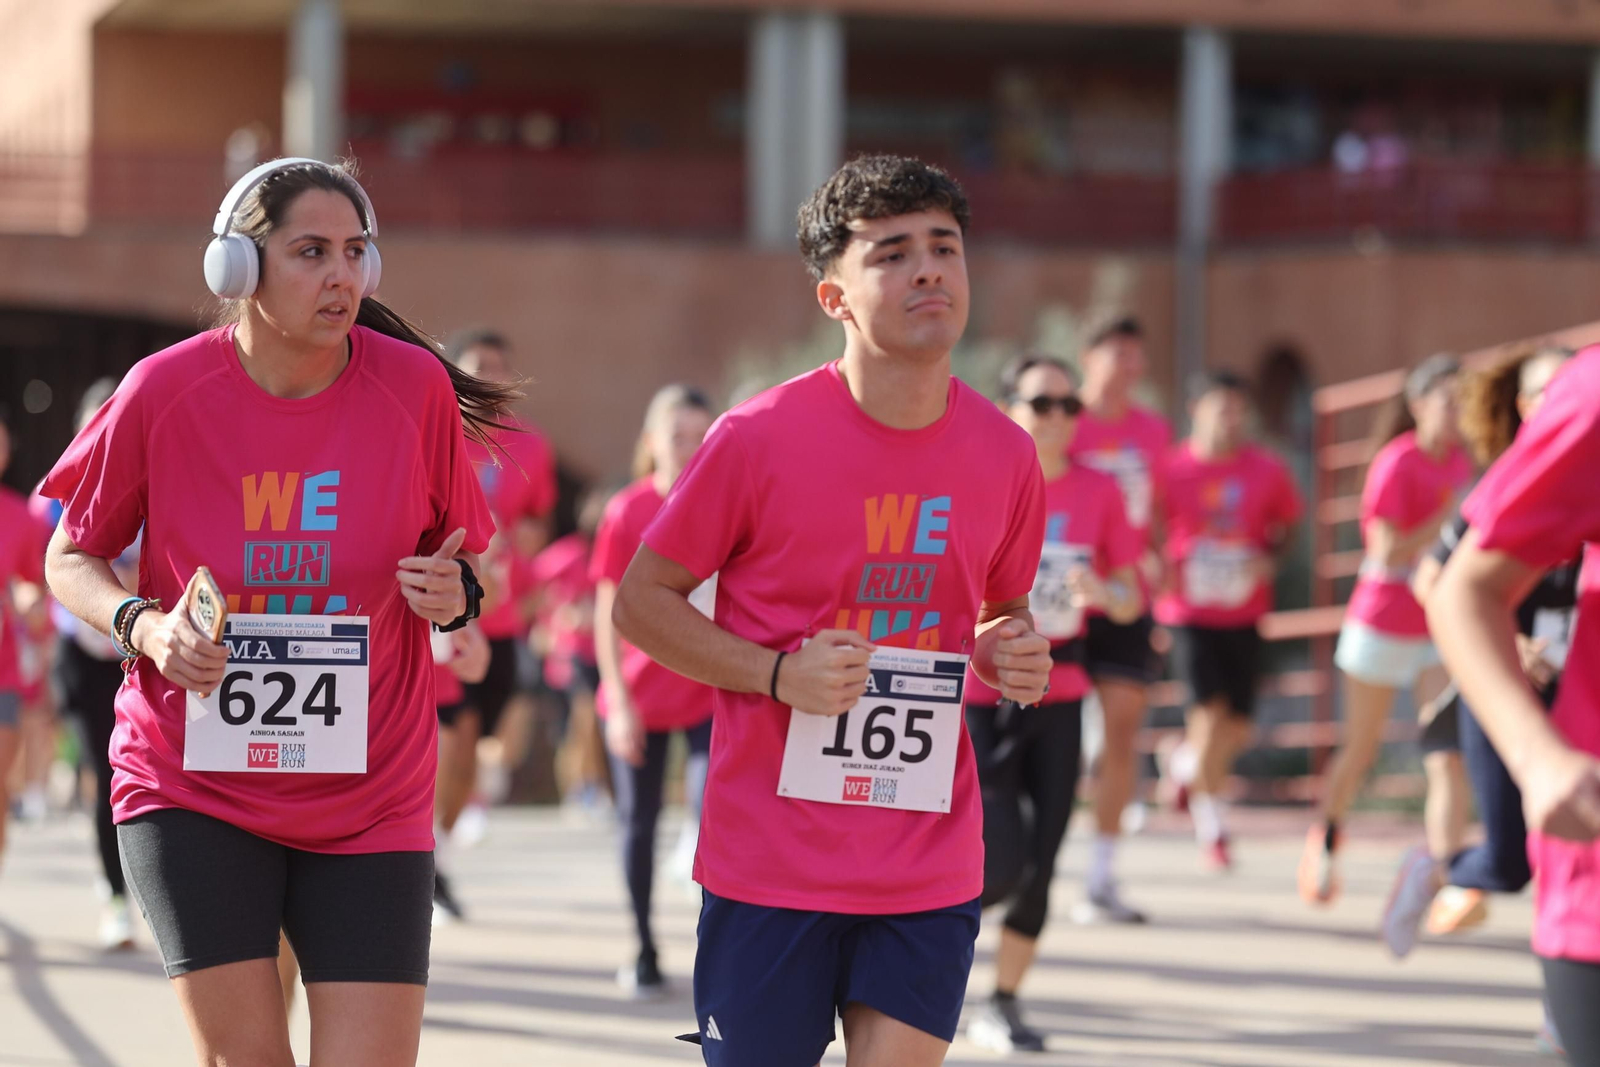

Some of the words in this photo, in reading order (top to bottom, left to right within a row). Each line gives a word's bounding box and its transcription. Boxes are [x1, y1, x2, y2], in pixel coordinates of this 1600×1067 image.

[242, 470, 340, 531] WE
[864, 493, 952, 555] WE
[250, 544, 326, 582] RUN
[861, 566, 933, 600] RUN
[235, 628, 284, 636] UNIVERSIDAD
[295, 628, 326, 637] MÁLAGA
[332, 647, 359, 655] uma.es
[219, 670, 341, 726] 624
[250, 729, 276, 737] AINHOA
[822, 705, 934, 763] 165
[281, 743, 306, 752] RUN
[248, 748, 278, 762] WE
[281, 759, 305, 768] RUN
[845, 781, 871, 796] WE
[875, 777, 898, 787] RUN
[872, 794, 896, 803] RUN
